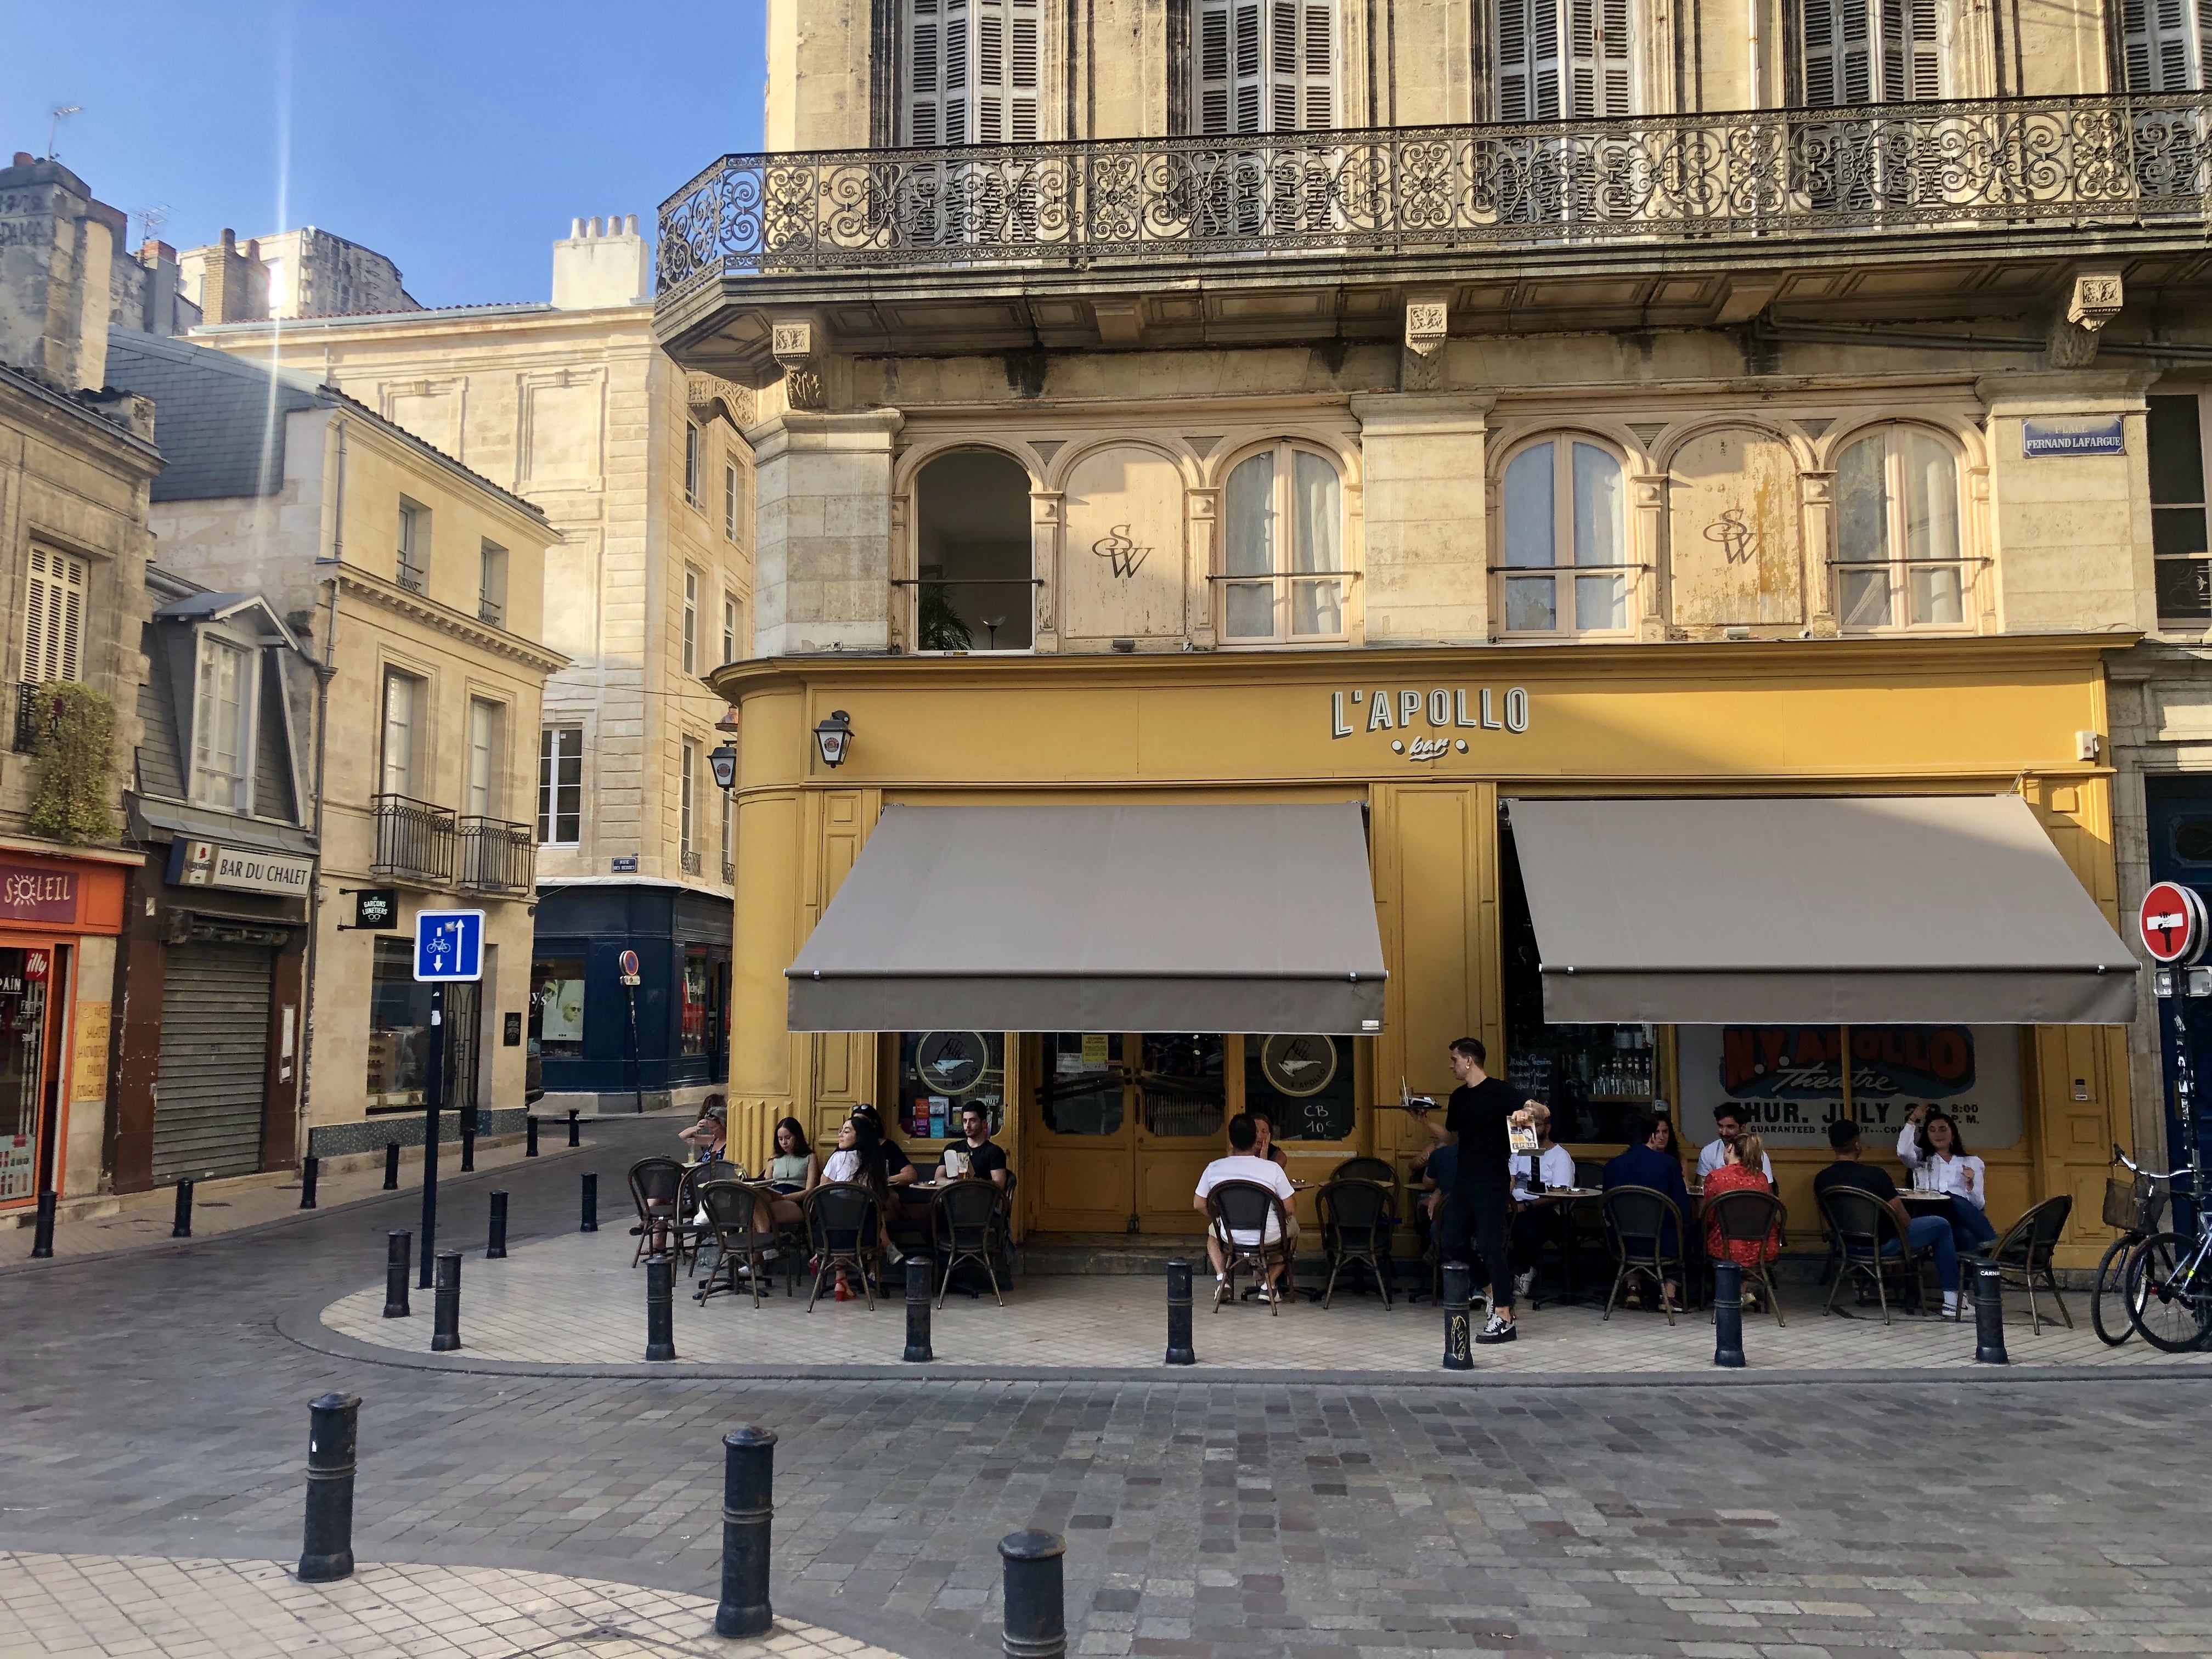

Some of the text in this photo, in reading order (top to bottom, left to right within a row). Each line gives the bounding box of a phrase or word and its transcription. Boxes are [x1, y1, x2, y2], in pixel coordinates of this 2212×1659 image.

[2055, 424, 2088, 434] PLACE
[2027, 437, 2121, 449] FERNAND LAFARGUE
[1331, 686, 1529, 740] L'APOLLO
[1409, 736, 1451, 758] bar
[220, 859, 243, 877] BAR
[245, 862, 264, 880] DU
[267, 866, 308, 885] CHALET
[4, 874, 70, 906] SOLEIL
[27, 952, 47, 977] illy
[1771, 1061, 1899, 1092] Theatre
[1304, 1105, 1328, 1117] CB
[1821, 1103, 1891, 1124] JULY
[1951, 1104, 1979, 1113] 8:00
